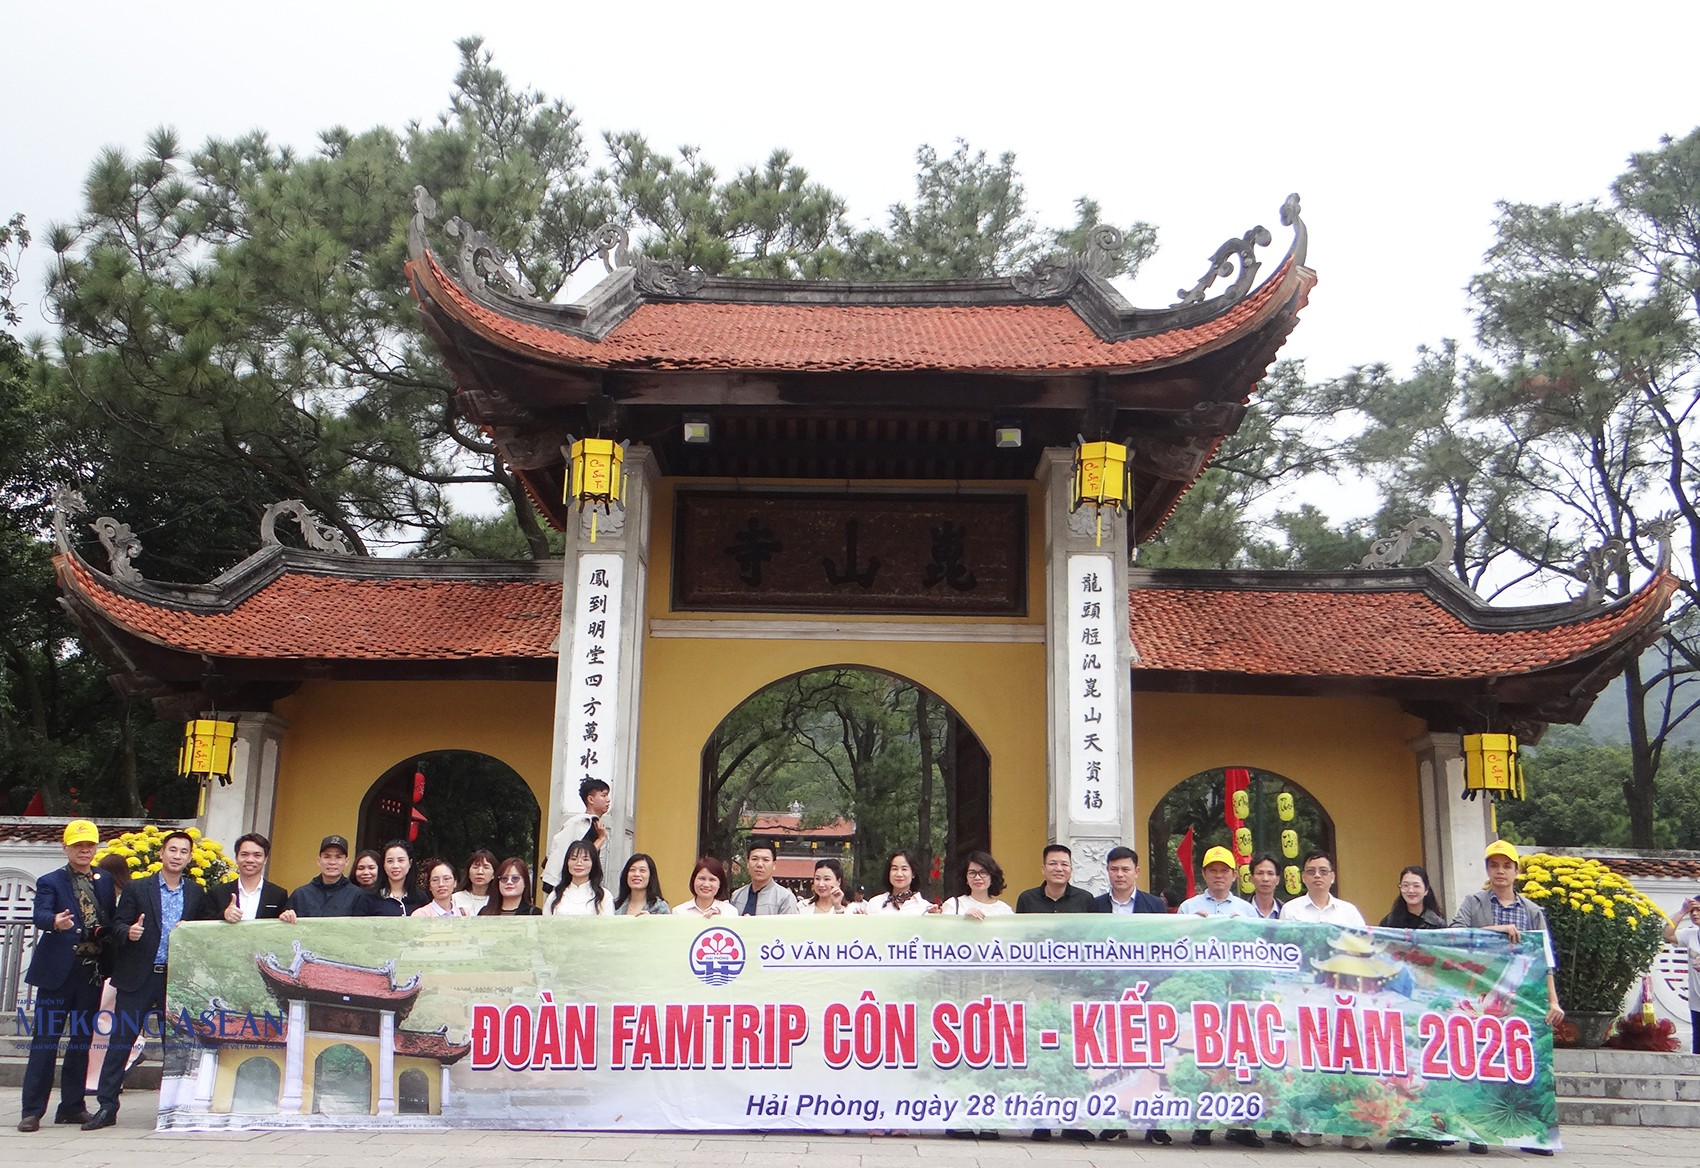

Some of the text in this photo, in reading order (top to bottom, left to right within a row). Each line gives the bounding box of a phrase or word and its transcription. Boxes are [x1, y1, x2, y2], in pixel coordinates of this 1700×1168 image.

[580, 568, 610, 787] 鳳到明堂四方萬水
[760, 937, 1299, 963] SỞ VĂN HÓA, THỂ THAO VÀ DU LỊCH THÀNH PHỐ HẢI PHÒNG
[470, 982, 1535, 1084] ĐOÀN FAMTRIP CÔN SƠN - KIẾP BẠC NĂM 2026
[746, 1094, 1261, 1121] Hải Phòng, ngày 28 tháng 02 năm 2026
